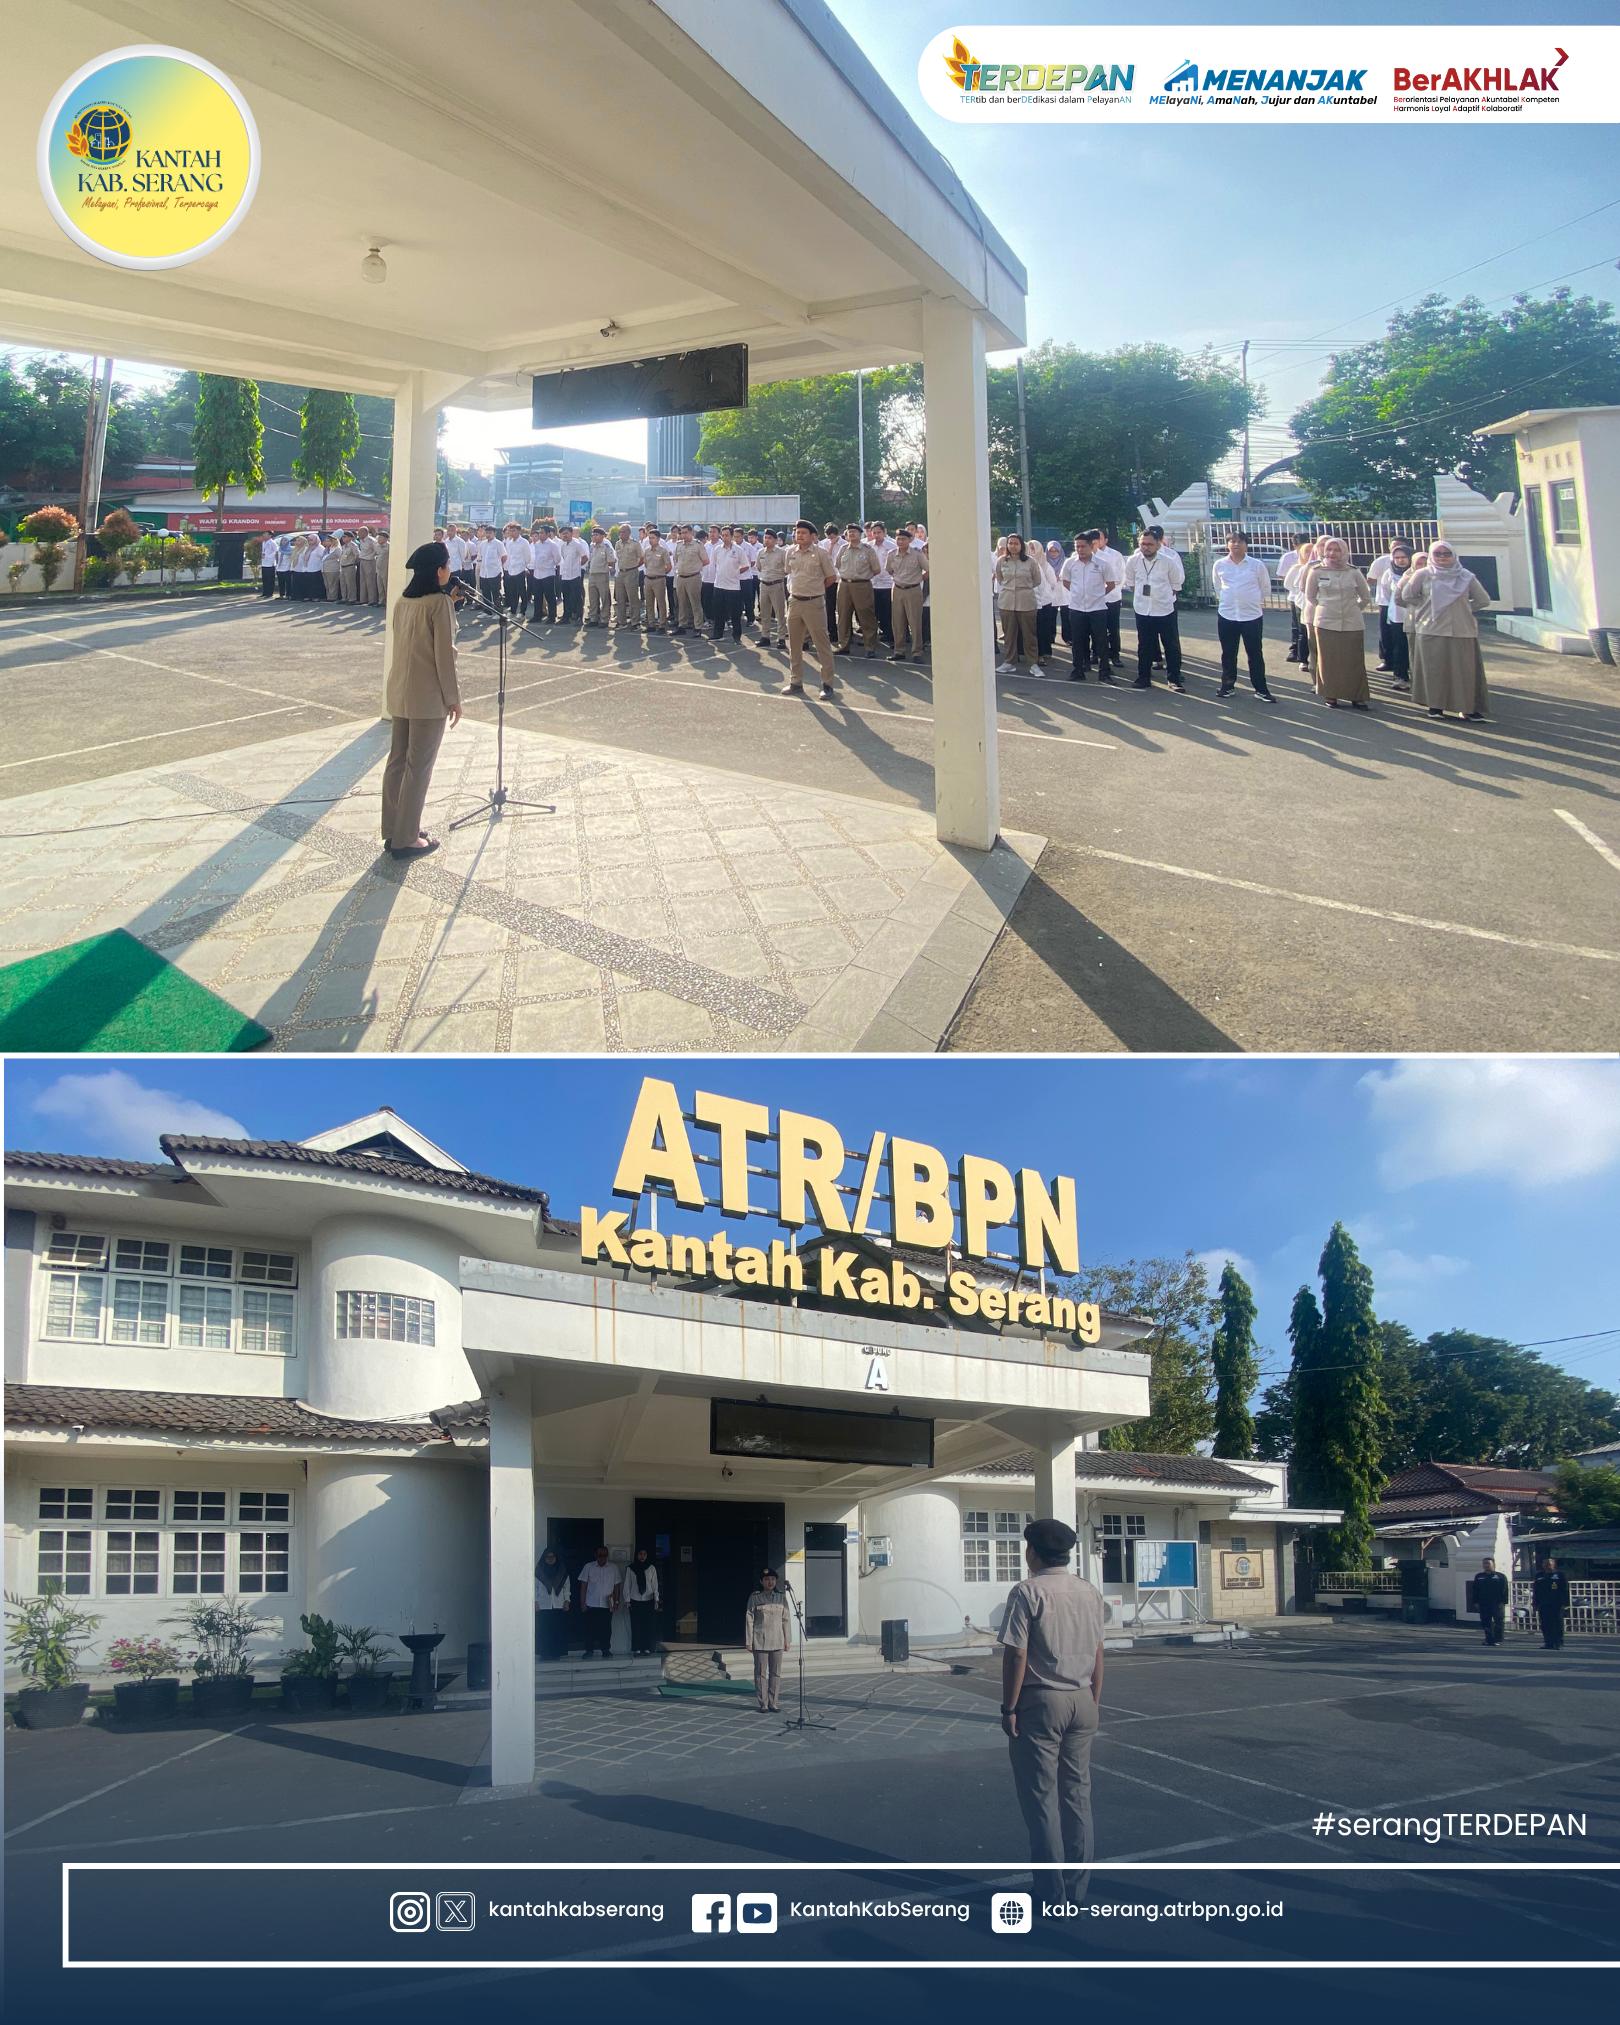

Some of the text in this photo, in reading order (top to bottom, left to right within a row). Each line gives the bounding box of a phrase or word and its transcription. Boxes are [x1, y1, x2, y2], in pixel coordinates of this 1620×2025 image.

[612, 1076, 1080, 1278] ATR/BPN
[580, 1205, 1102, 1346] Kantah Kab. Serang
[865, 1357, 889, 1390] A
